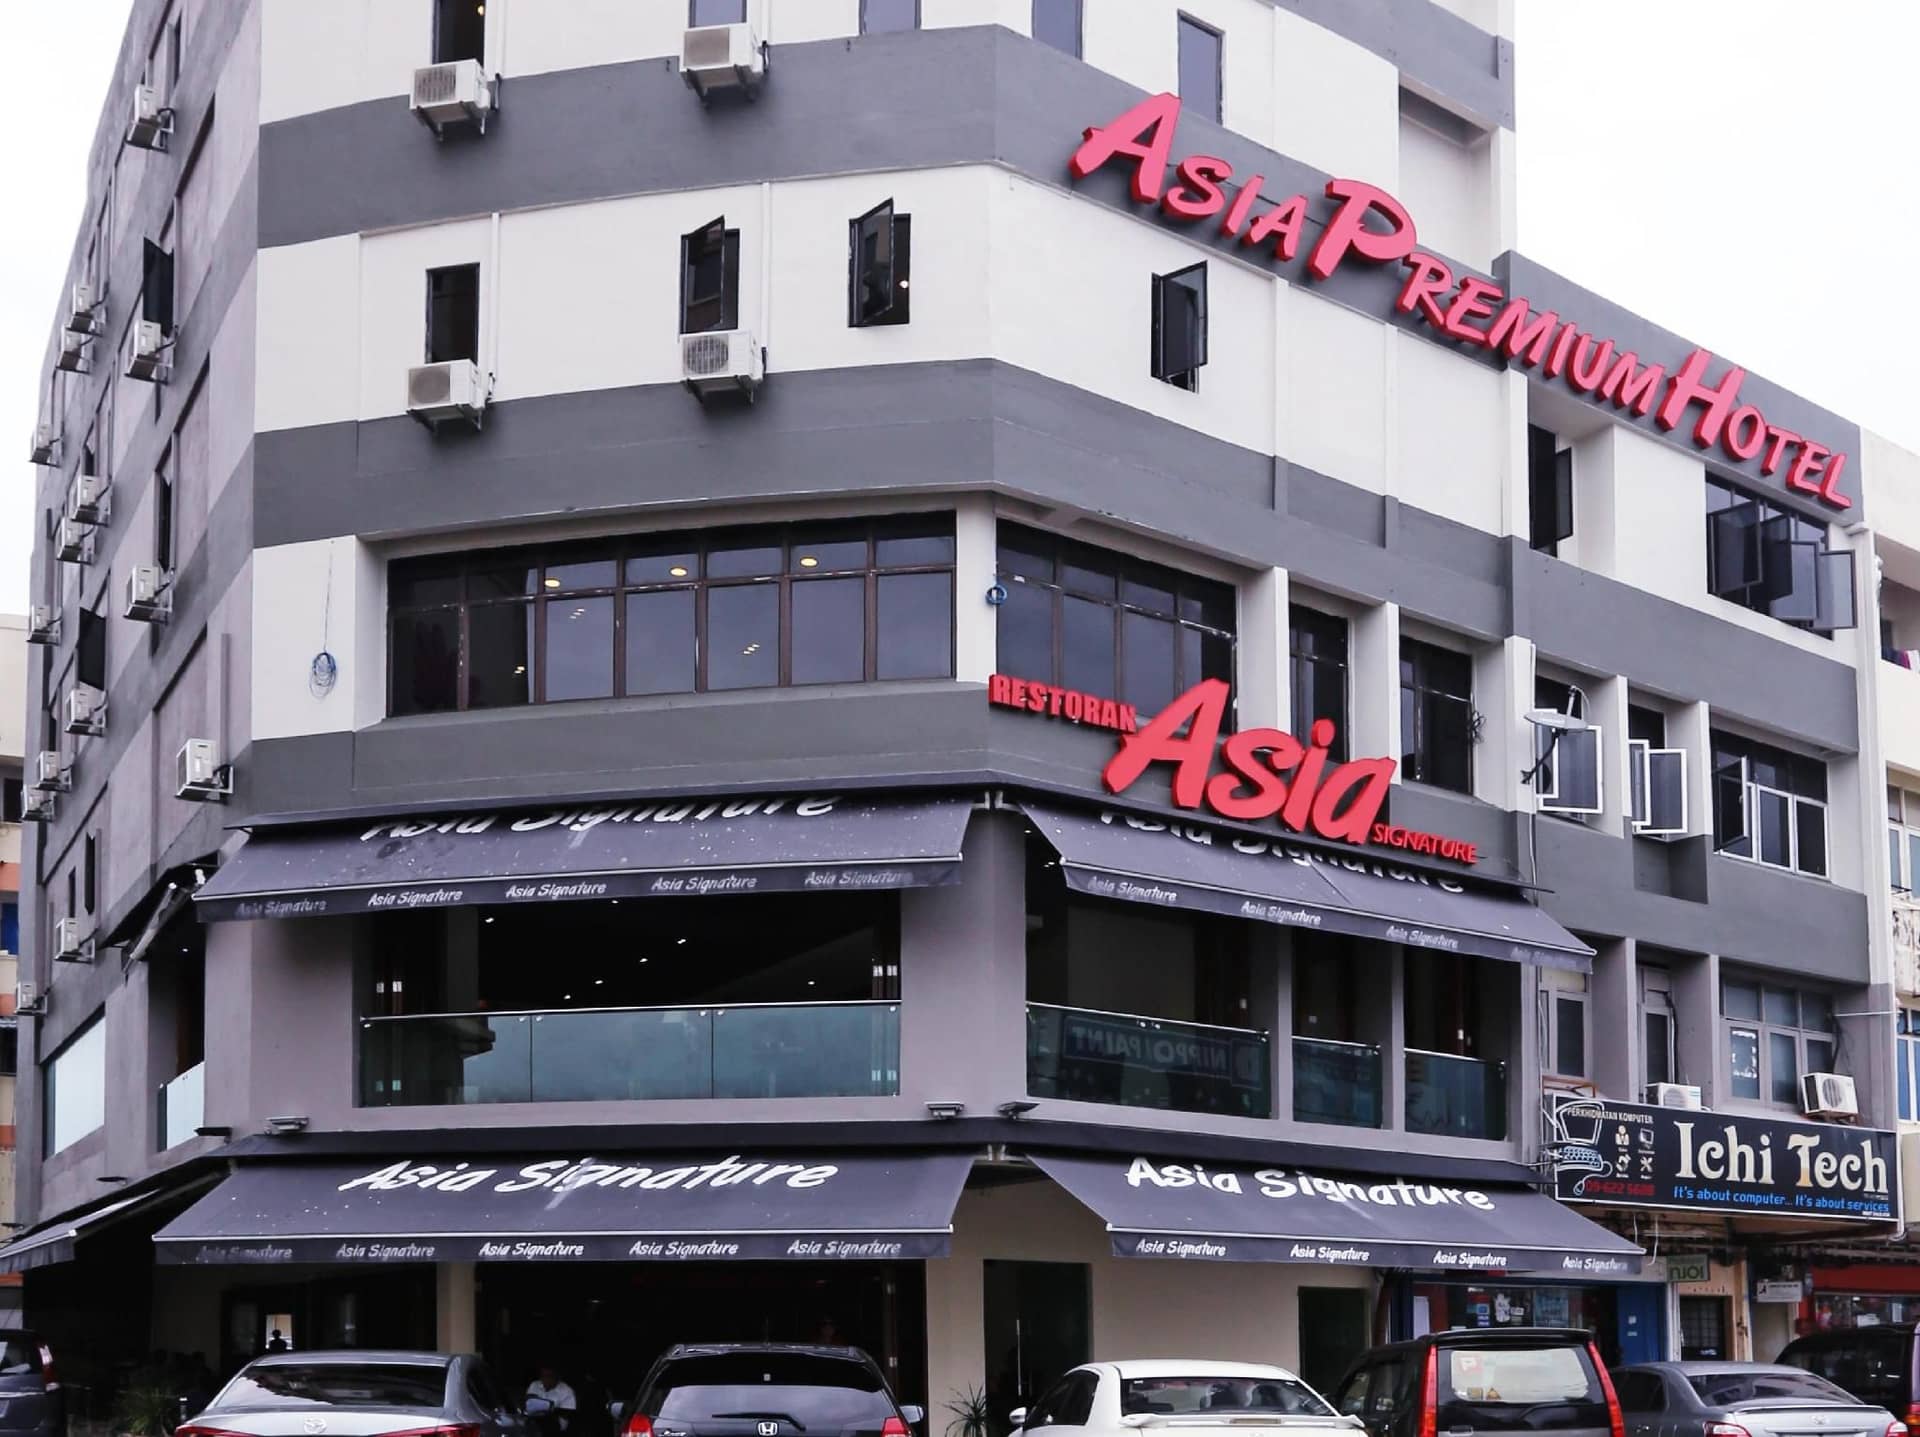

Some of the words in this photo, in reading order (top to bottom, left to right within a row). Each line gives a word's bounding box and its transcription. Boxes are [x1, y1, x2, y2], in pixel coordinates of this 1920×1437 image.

[989, 674, 1137, 733] RESTORAN
[1103, 677, 1396, 845] Asia
[1372, 822, 1479, 866] SIGNATURE
[652, 877, 683, 892] Asia
[685, 874, 758, 895] Signature
[804, 871, 836, 885] Asia
[368, 891, 395, 906] Asia
[397, 888, 463, 908] Signature
[505, 883, 536, 899] Asia
[537, 881, 607, 900] Signature
[1116, 881, 1177, 901] Signature
[1267, 905, 1321, 925] Signature
[1408, 930, 1459, 949] Signature
[1673, 1120, 1775, 1185] Ichi
[1787, 1133, 1889, 1194] Tech
[338, 1160, 497, 1192] Asia
[495, 1155, 839, 1193] Signature
[1125, 1156, 1243, 1194] Asia
[1254, 1168, 1496, 1211] Signature
[1674, 1186, 1694, 1200] It's
[1696, 1188, 1732, 1201] about
[1795, 1193, 1813, 1207] It's
[1815, 1196, 1846, 1209] about
[1847, 1199, 1889, 1214] services
[336, 1243, 366, 1258] Asia
[368, 1241, 435, 1261] Signature
[478, 1241, 509, 1257] Asia
[511, 1239, 585, 1260] Signature
[628, 1240, 663, 1256] Asia
[664, 1240, 739, 1260] Signature
[787, 1239, 822, 1254] Asia
[824, 1239, 902, 1259] Signature
[1135, 1238, 1164, 1254] Asia
[1166, 1240, 1227, 1258] Signature
[1290, 1243, 1316, 1258] Asia
[1317, 1245, 1370, 1263] Signature
[1433, 1250, 1457, 1265] Asia
[1458, 1252, 1508, 1269] Signature
[1562, 1255, 1583, 1270] Asia
